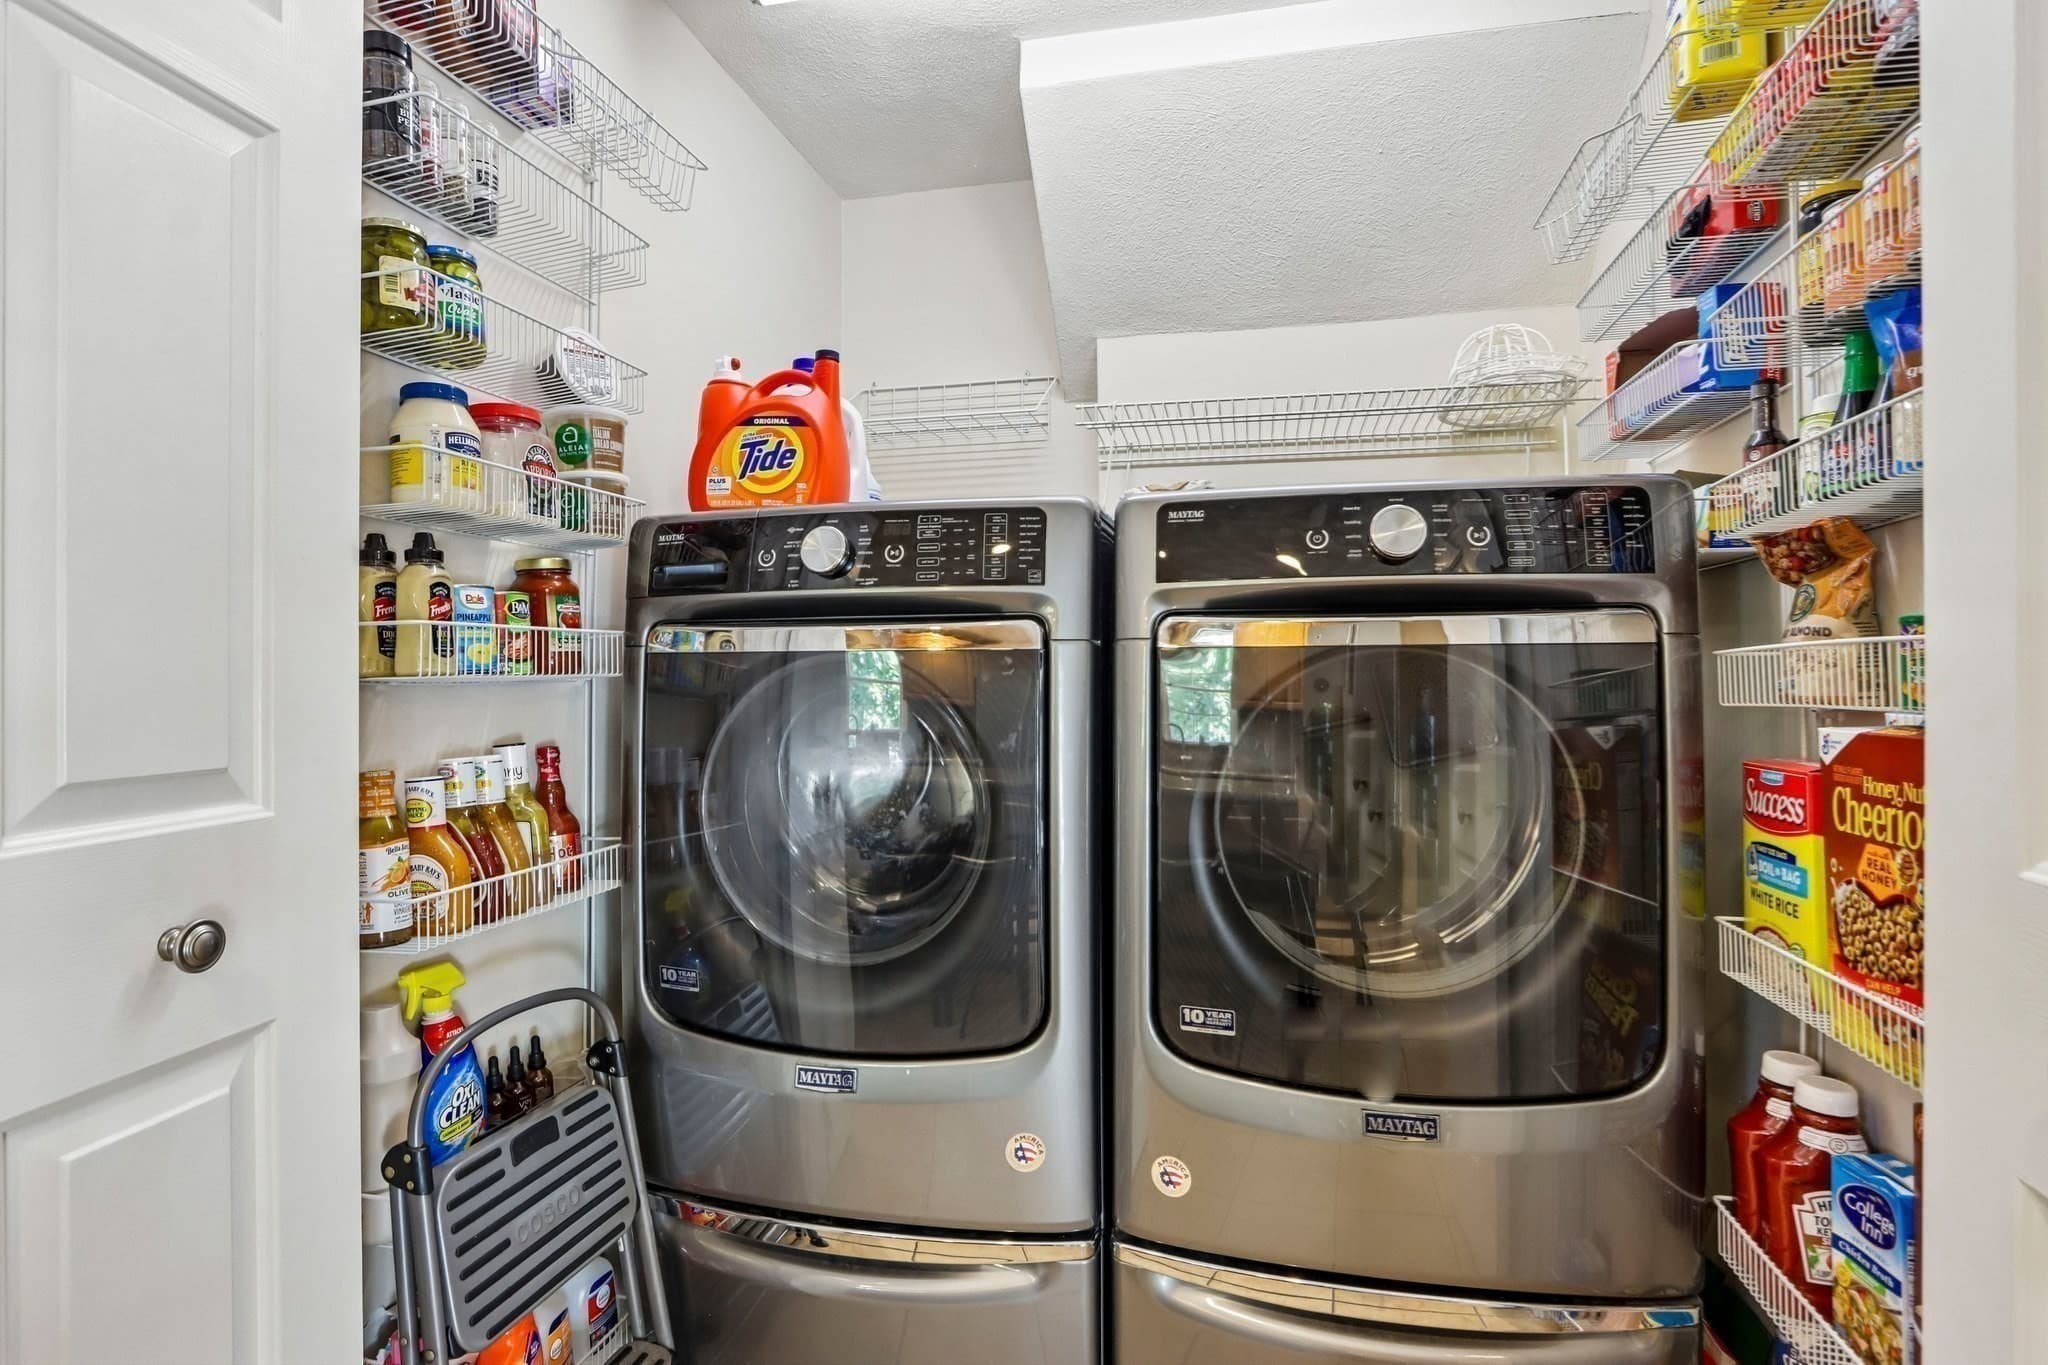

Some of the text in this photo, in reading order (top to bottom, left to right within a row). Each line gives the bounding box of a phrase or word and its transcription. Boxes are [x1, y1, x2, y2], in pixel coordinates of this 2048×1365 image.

[736, 438, 798, 482] Tide
[1167, 510, 1205, 519] MAYTAG
[658, 533, 685, 542] MAYTAG
[465, 593, 485, 603] Dole
[1745, 778, 1805, 825] Success
[1862, 775, 1904, 806] Honey
[1866, 857, 1892, 875] REAL
[1862, 869, 1897, 890] HONEY
[1750, 886, 1800, 919] WHITE RICE
[661, 967, 697, 982] 10 YEAR
[1183, 1008, 1232, 1024] 10 YEAR
[798, 1070, 854, 1088] MAYTAG
[440, 1090, 482, 1129] CLEAN
[1367, 1115, 1436, 1136] MAYTAG
[1014, 1134, 1045, 1156] AMERICA
[1157, 1158, 1190, 1180] AMERICA
[517, 1182, 581, 1243] COSCO
[1843, 1192, 1896, 1237] College
[1860, 1216, 1885, 1245] Inn
[1837, 1240, 1896, 1288] Chicken Broth
